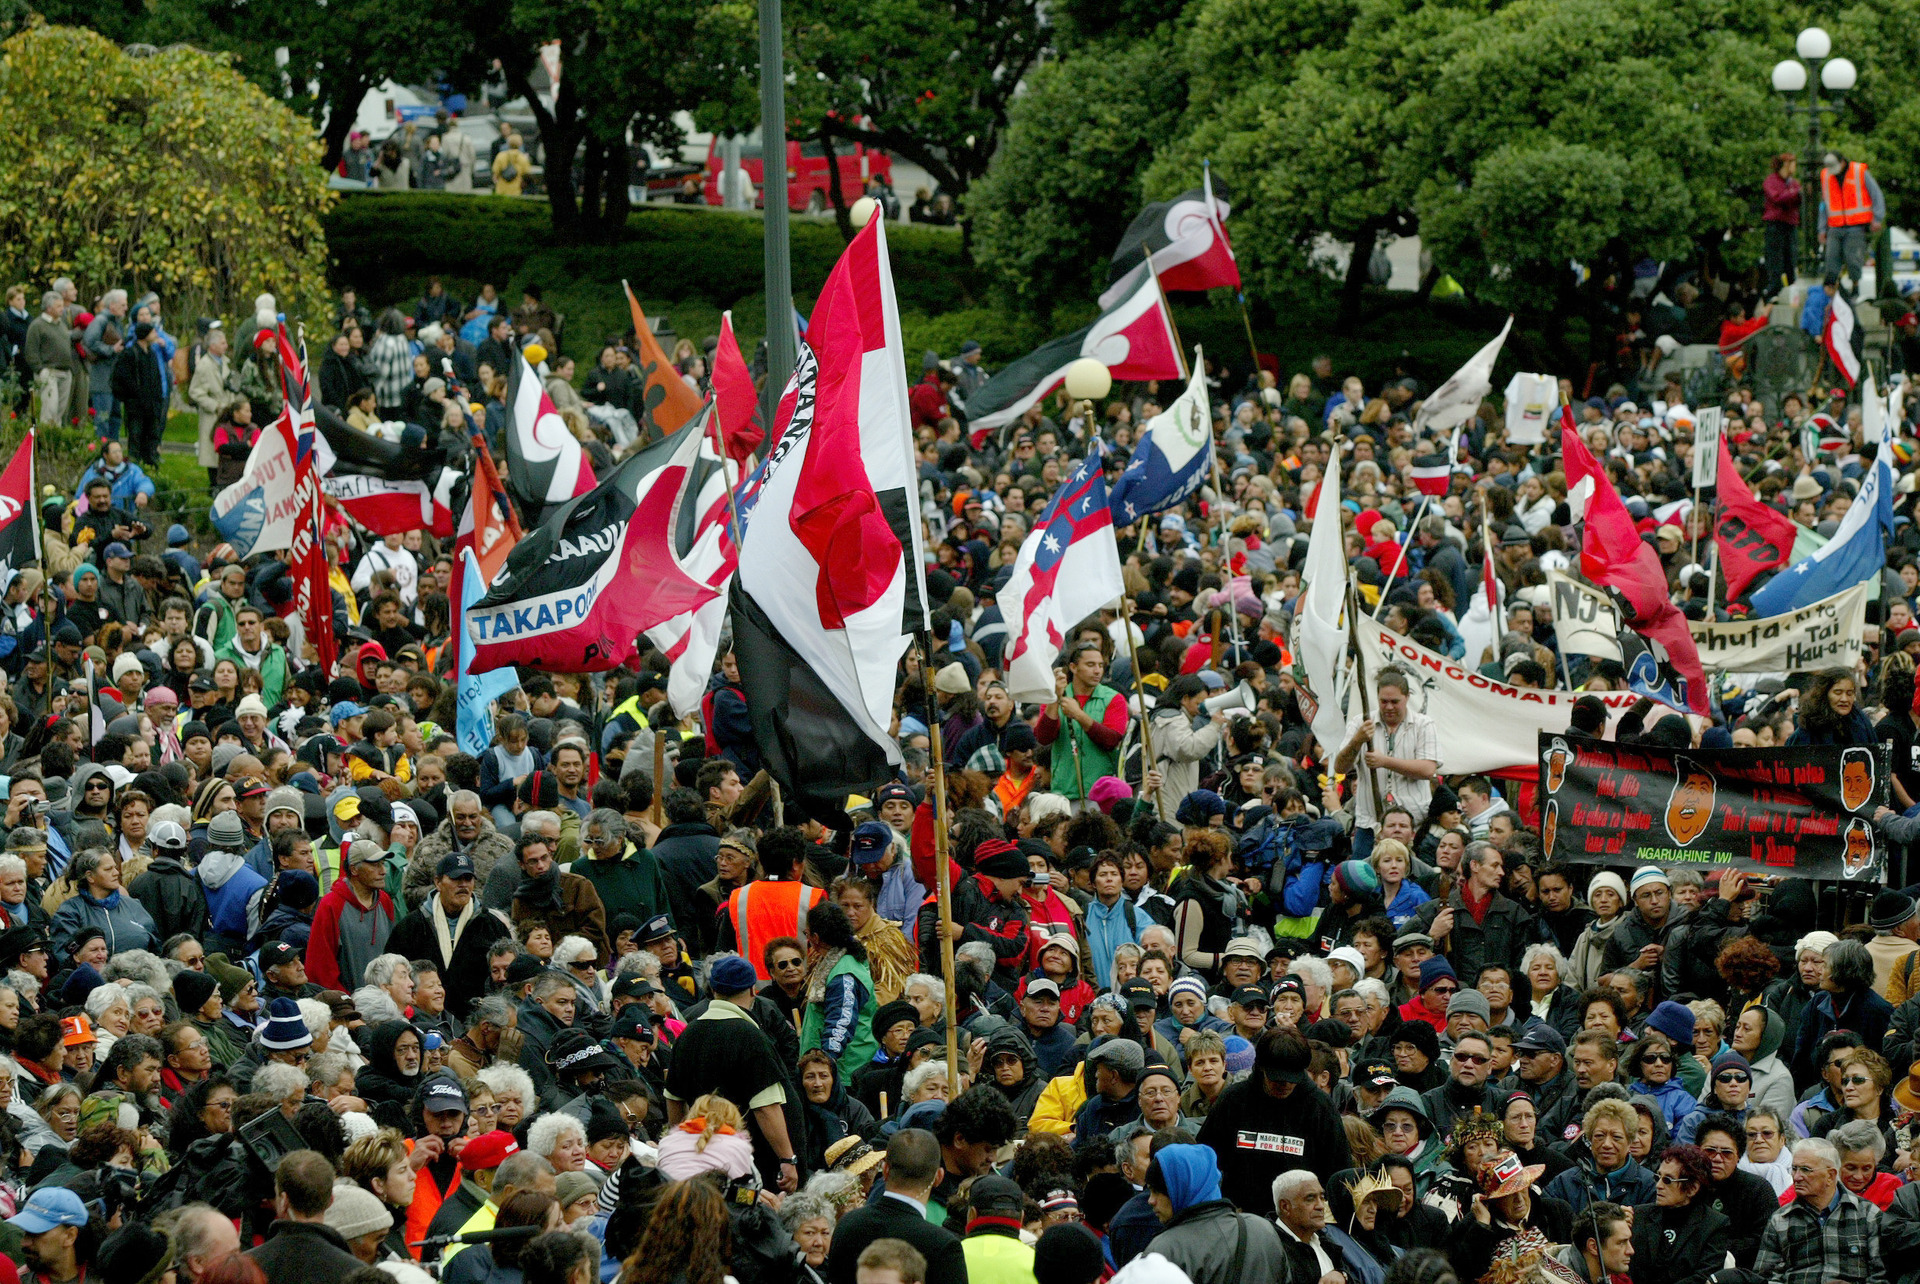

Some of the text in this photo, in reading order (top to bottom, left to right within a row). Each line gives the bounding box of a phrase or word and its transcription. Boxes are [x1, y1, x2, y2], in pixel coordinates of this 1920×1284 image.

[1805, 618, 1839, 642] Tai
[1636, 847, 1733, 864] NGARUAHINE IWI
